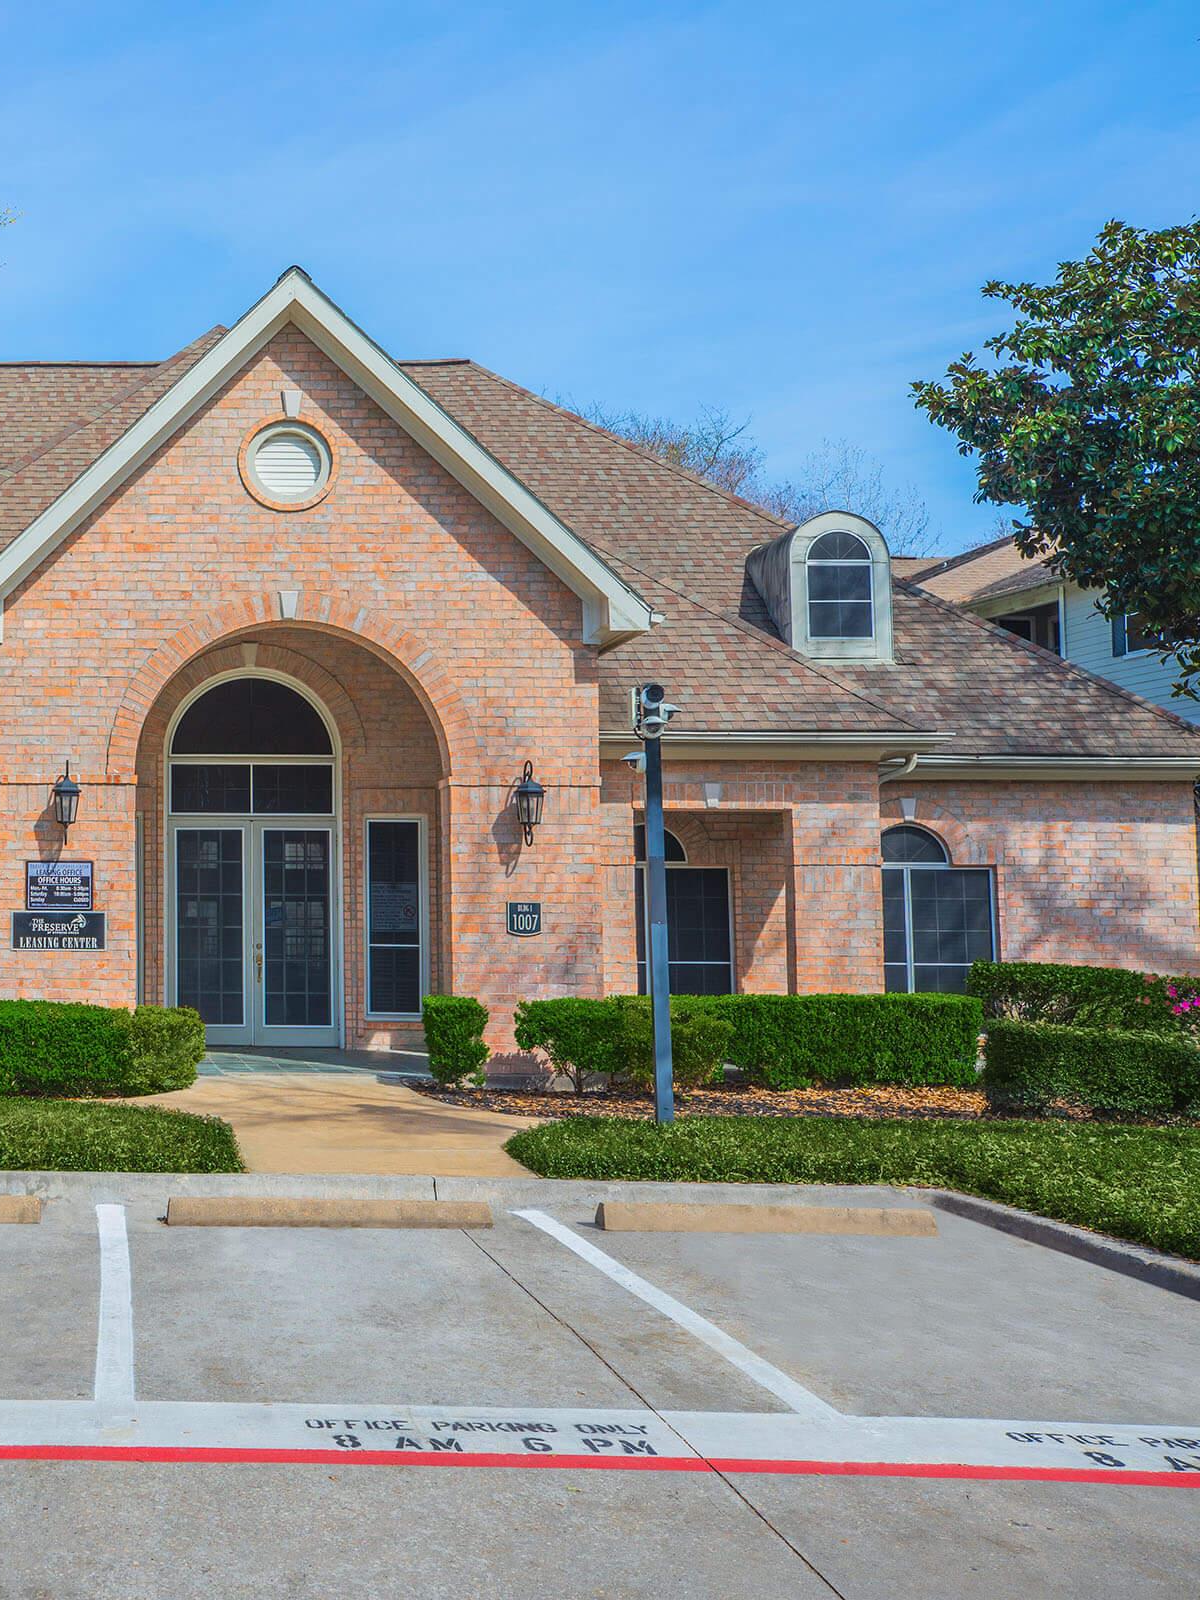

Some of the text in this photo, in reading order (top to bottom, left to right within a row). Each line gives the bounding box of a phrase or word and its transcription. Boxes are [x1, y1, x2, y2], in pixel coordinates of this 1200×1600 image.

[32, 923, 80, 931] PRESERVE
[513, 914, 538, 930] 1007
[20, 937, 97, 948] LEASING CENTER
[304, 1419, 649, 1435] OFFICE PARKING ONLY
[333, 1434, 658, 1456] 8 AM 6 PM
[1005, 1432, 1200, 1449] OFFICE PAR
[1083, 1451, 1126, 1468] 8
